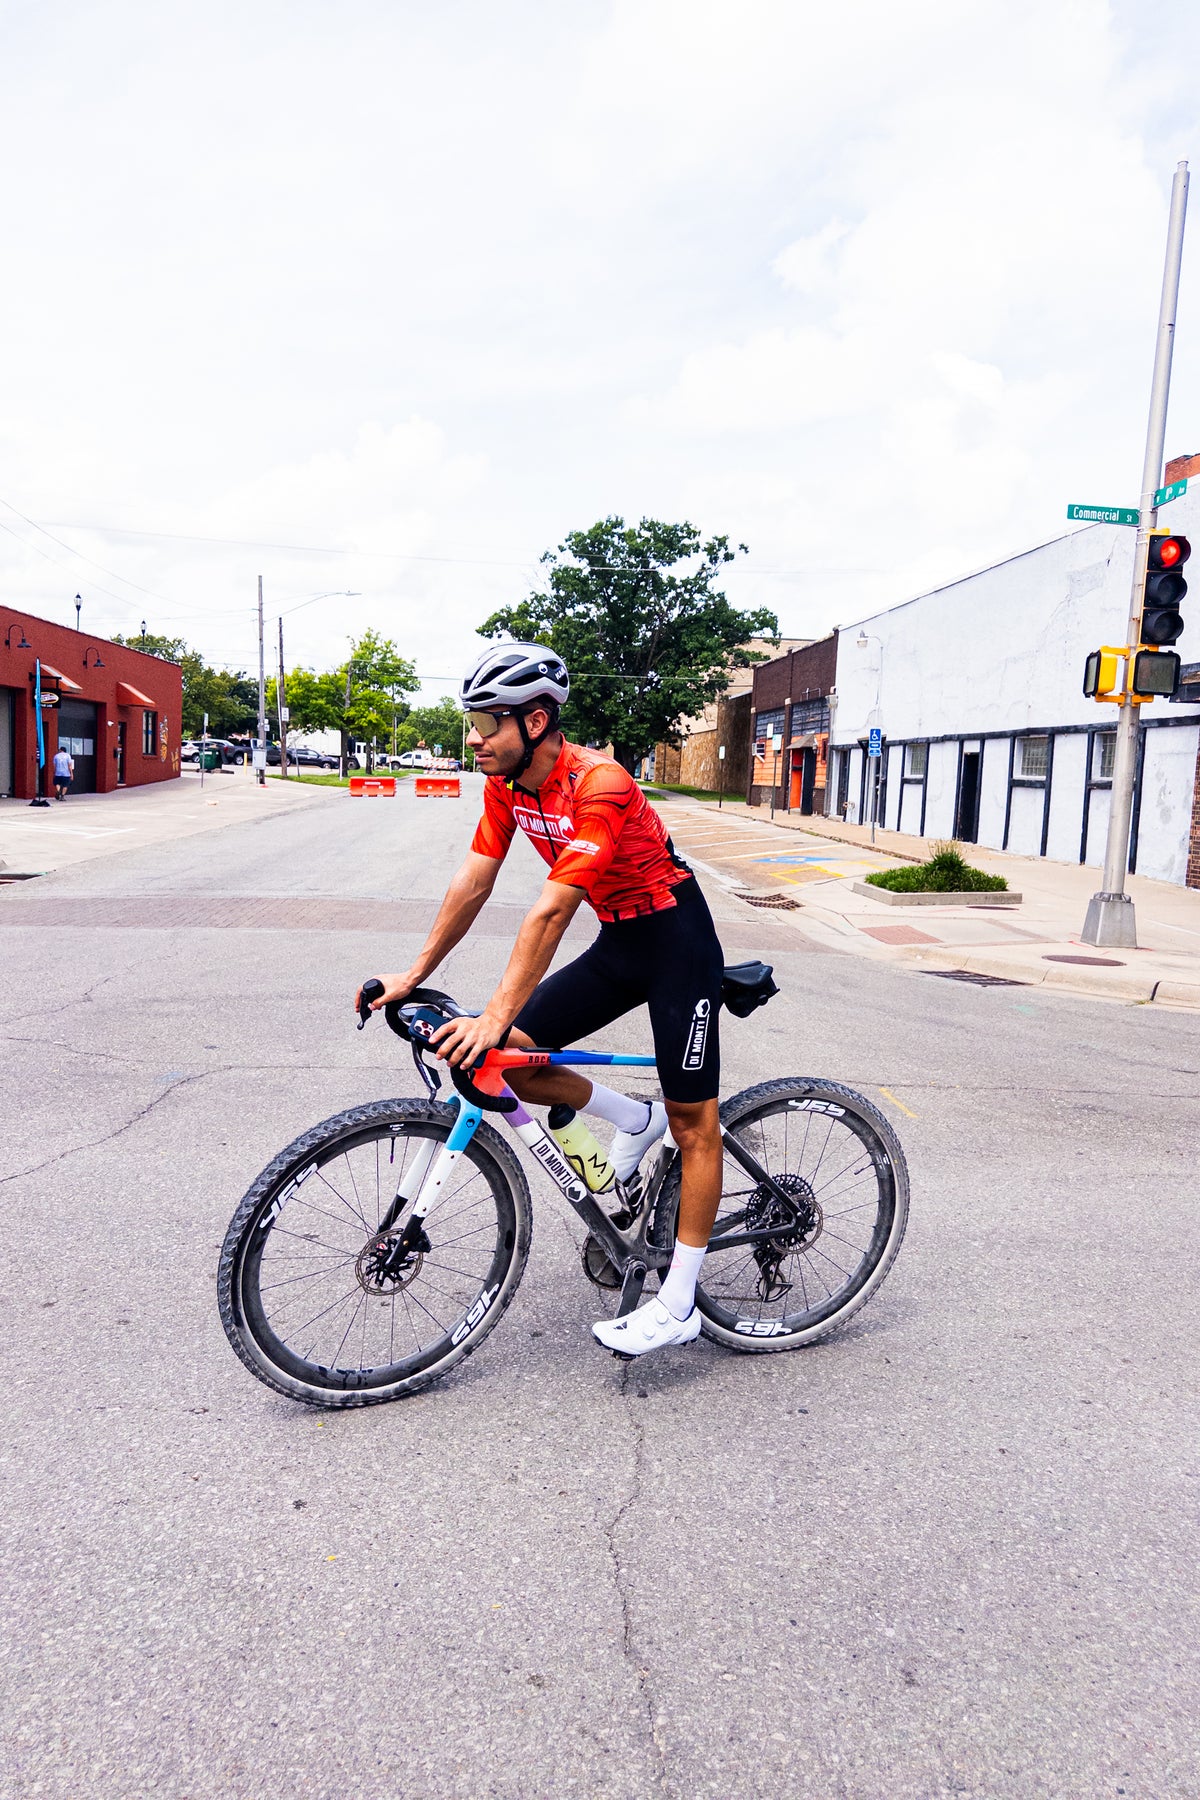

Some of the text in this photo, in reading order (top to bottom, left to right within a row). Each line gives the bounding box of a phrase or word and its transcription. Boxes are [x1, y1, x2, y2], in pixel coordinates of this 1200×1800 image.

[1073, 506, 1133, 523] Commercial St
[518, 814, 561, 836] DI MONTI
[689, 1020, 706, 1065] DI MONTI
[536, 1143, 573, 1185] DI MONTI
